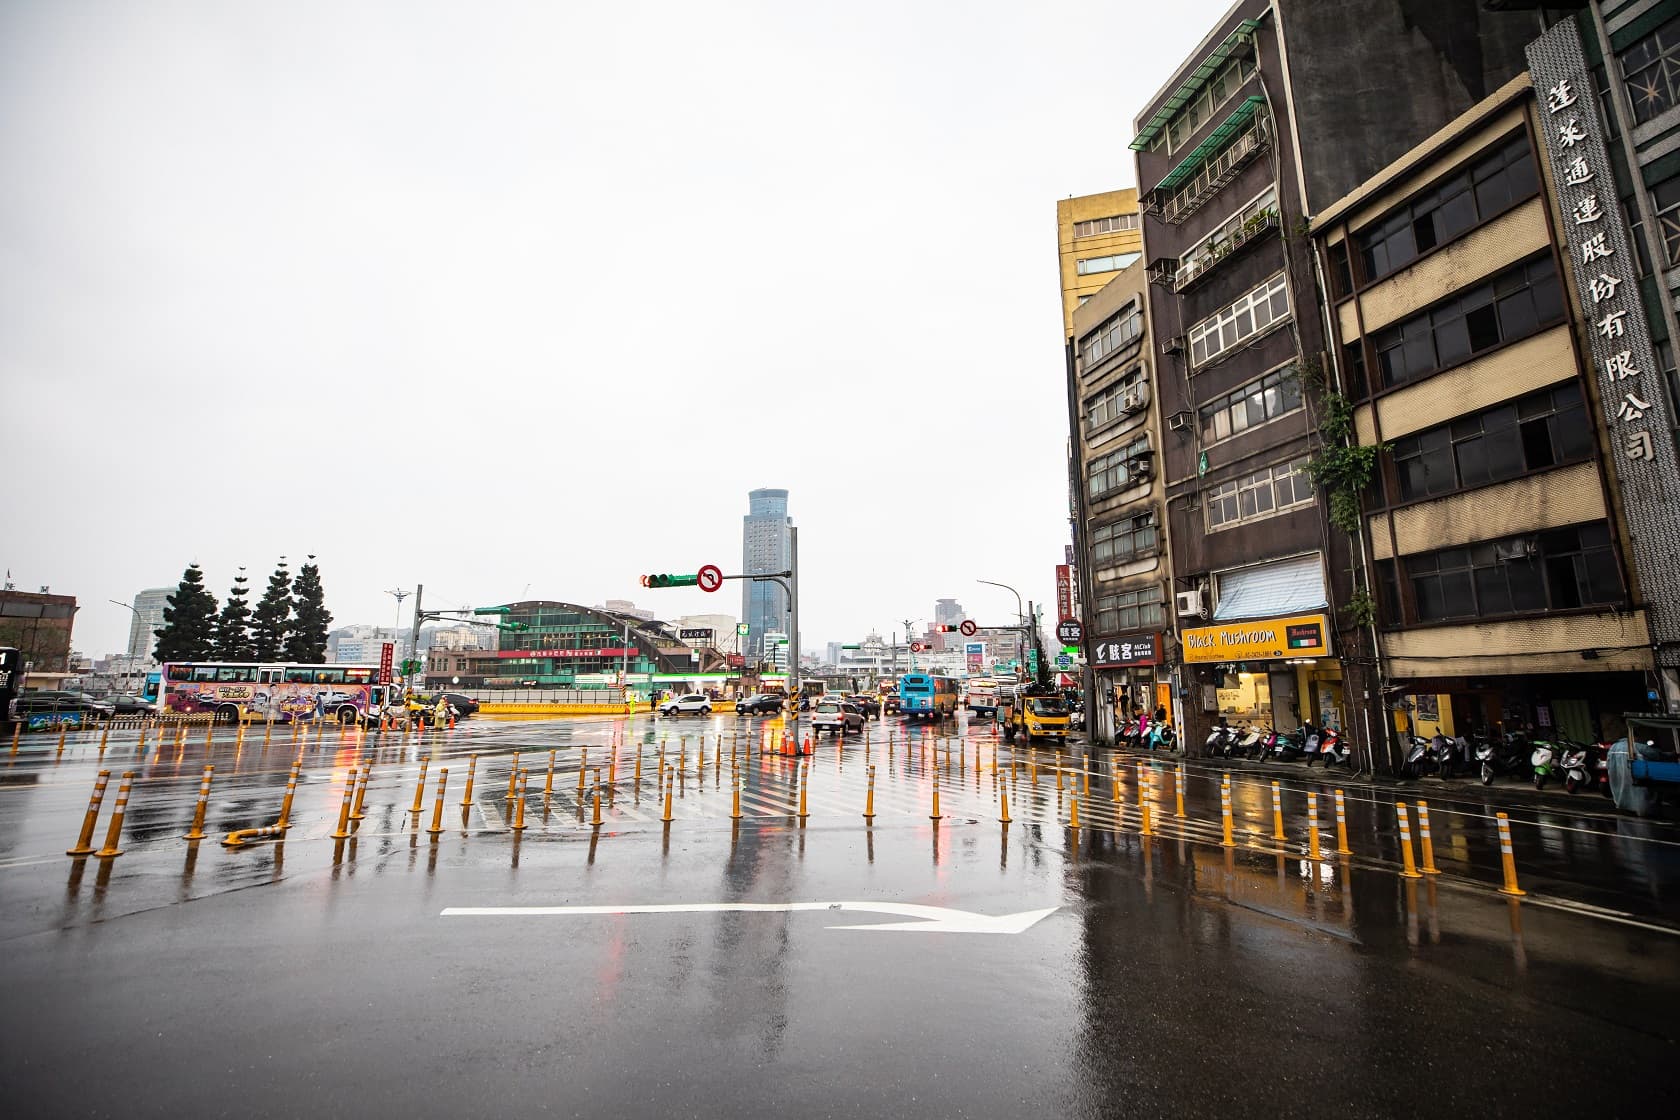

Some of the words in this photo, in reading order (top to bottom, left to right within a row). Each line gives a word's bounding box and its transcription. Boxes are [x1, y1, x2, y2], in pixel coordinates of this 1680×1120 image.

[1547, 79, 1656, 463] 蓬萊通運股份有限公司
[1187, 633, 1216, 648] Black
[1220, 629, 1277, 646] Mushroom
[1109, 643, 1132, 661] 駭客
